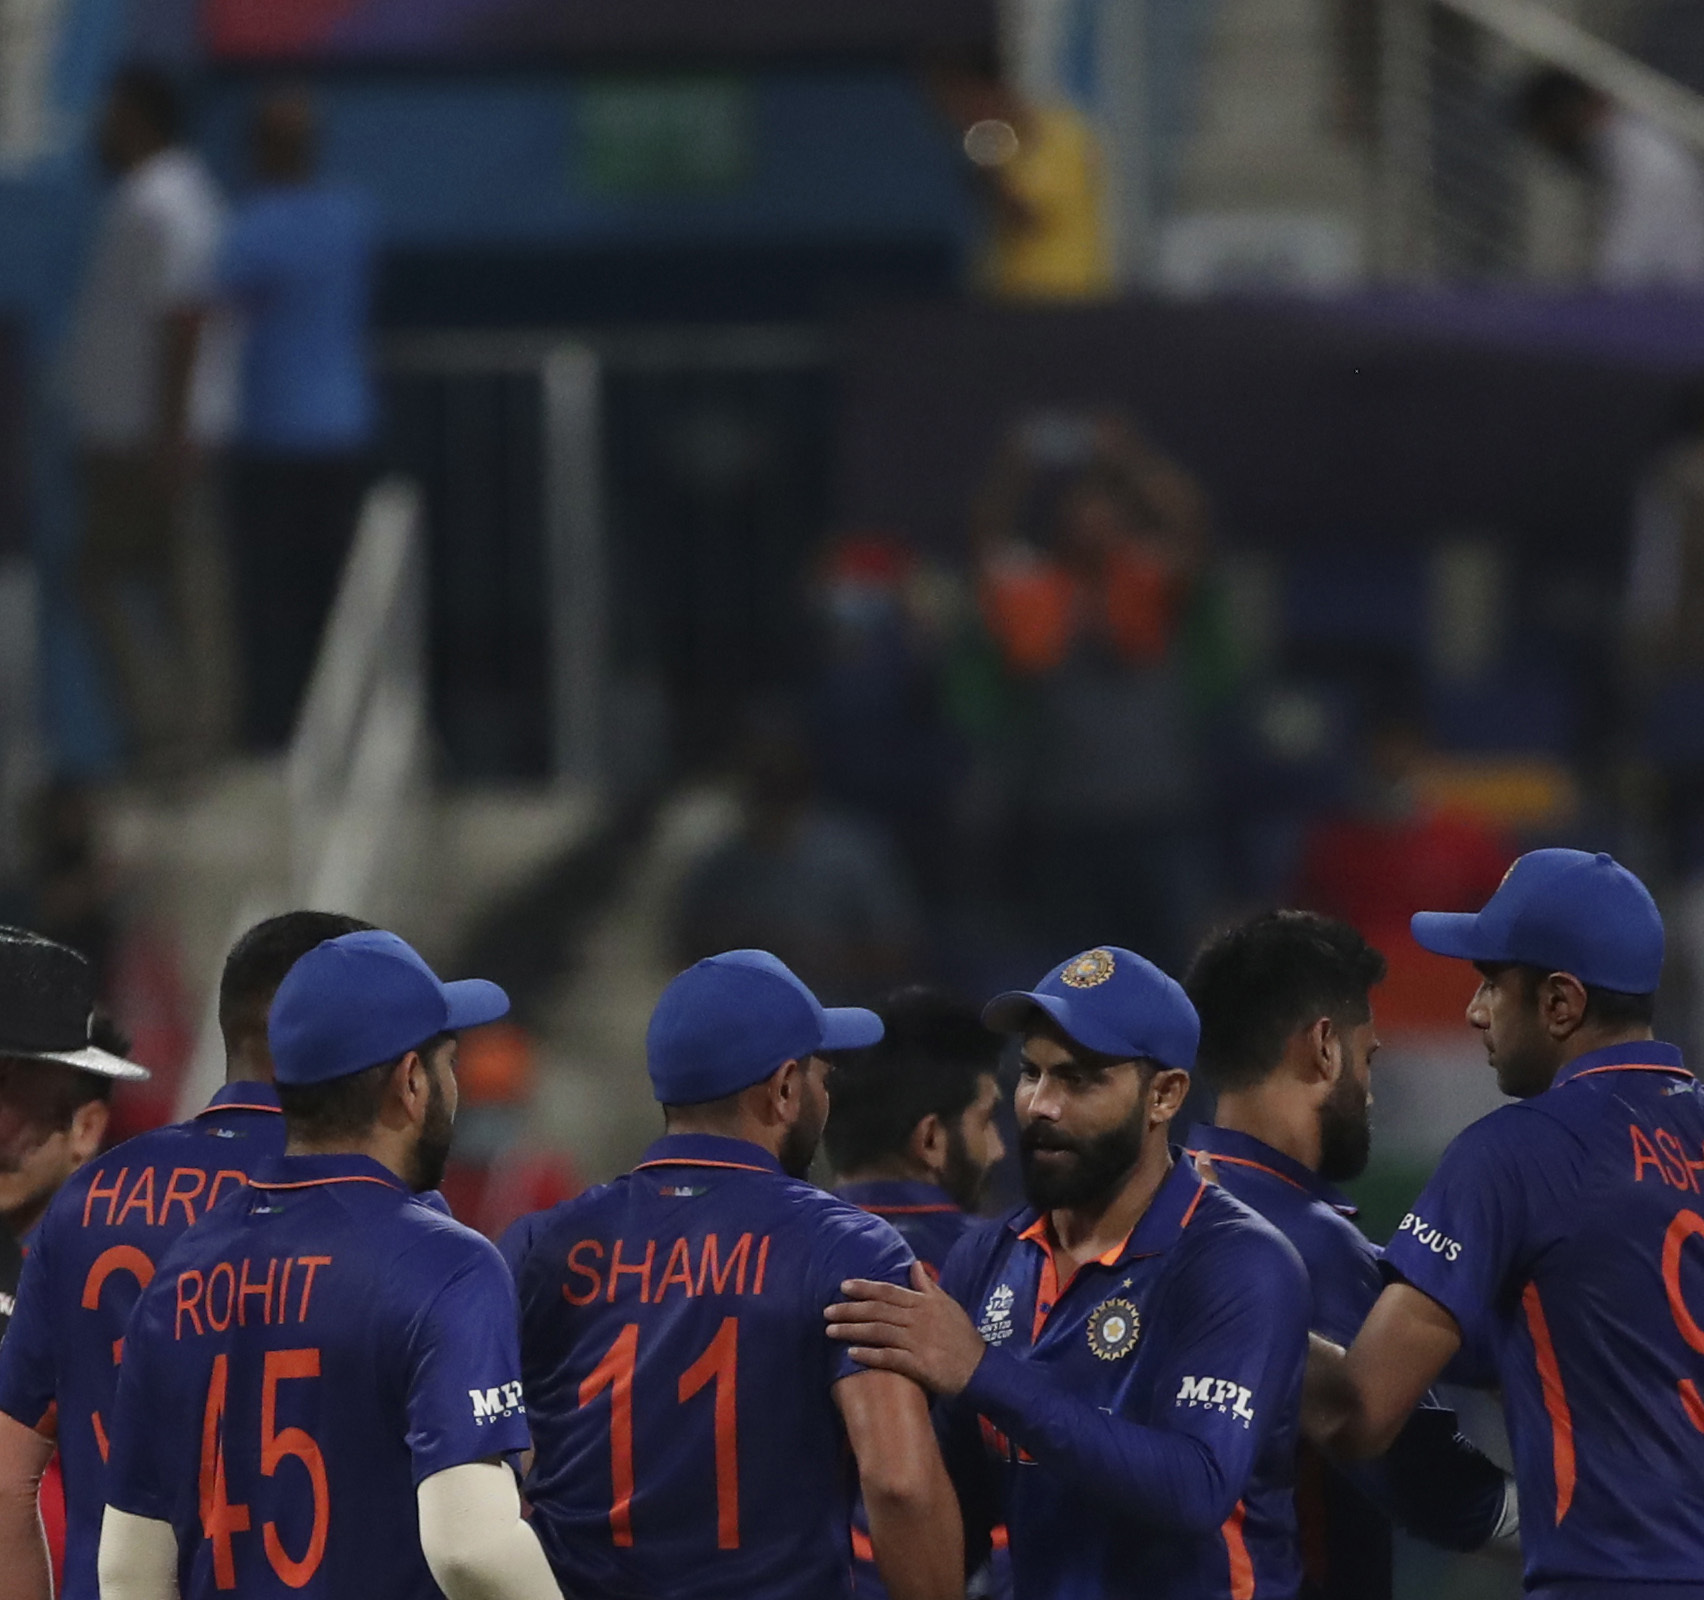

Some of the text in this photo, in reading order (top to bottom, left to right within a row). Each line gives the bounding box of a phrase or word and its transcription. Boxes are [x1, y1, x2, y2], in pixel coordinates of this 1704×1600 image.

[1398, 1212, 1462, 1261] BYJU'S
[561, 1232, 770, 1306] SHAMI
[174, 1255, 332, 1341] ROHIT
[468, 1380, 523, 1417] MP
[475, 1405, 526, 1426] SPOR
[1175, 1400, 1250, 1430] SPORTS
[1176, 1375, 1254, 1420] MPL
[577, 1316, 740, 1549] 11
[198, 1347, 330, 1590] 45
